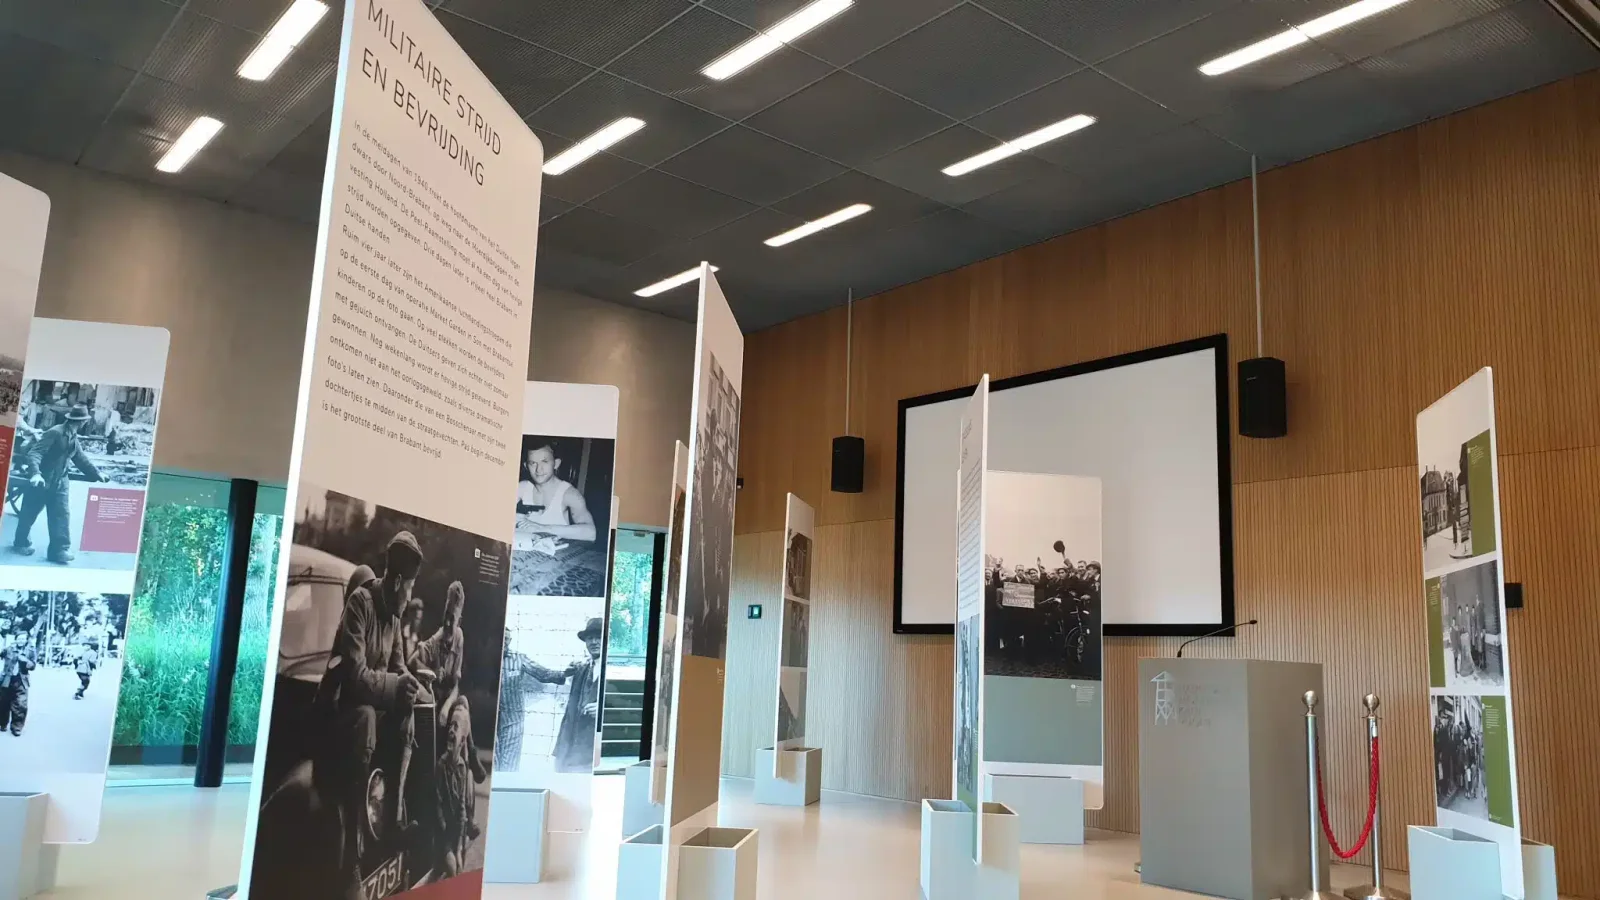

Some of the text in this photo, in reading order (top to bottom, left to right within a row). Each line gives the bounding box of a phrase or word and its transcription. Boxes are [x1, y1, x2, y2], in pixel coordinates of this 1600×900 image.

[368, 0, 502, 156] MILITAIRE STRIJD
[362, 47, 485, 187] EN BEVRIJDING
[351, 141, 372, 165] dwars
[373, 159, 387, 178] door
[354, 119, 361, 133] In
[362, 126, 371, 141] de
[372, 137, 401, 168] meidagen
[349, 164, 373, 191] vesting
[344, 204, 366, 227] Duitse
[347, 185, 364, 203] strijd
[365, 199, 388, 222] worden
[342, 225, 359, 245] Ruim
[360, 240, 373, 255] vier
[373, 248, 386, 264] jaar
[339, 249, 349, 264] op
[350, 254, 359, 267] de
[360, 262, 380, 281] eerste
[337, 268, 366, 294] kinderen
[367, 289, 376, 303] op
[334, 292, 348, 306] met
[349, 301, 373, 321] gejuich
[329, 336, 363, 359] ontkomen
[364, 354, 377, 366] niet
[370, 333, 383, 350] Nog
[327, 356, 347, 374] foto's
[348, 366, 365, 383] laten
[324, 378, 363, 404] dochtertjes
[364, 397, 371, 408] te
[372, 402, 396, 419] midden
[322, 401, 329, 412] is
[330, 404, 342, 418] het
[343, 412, 371, 430] grootste
[372, 422, 386, 436] deel
